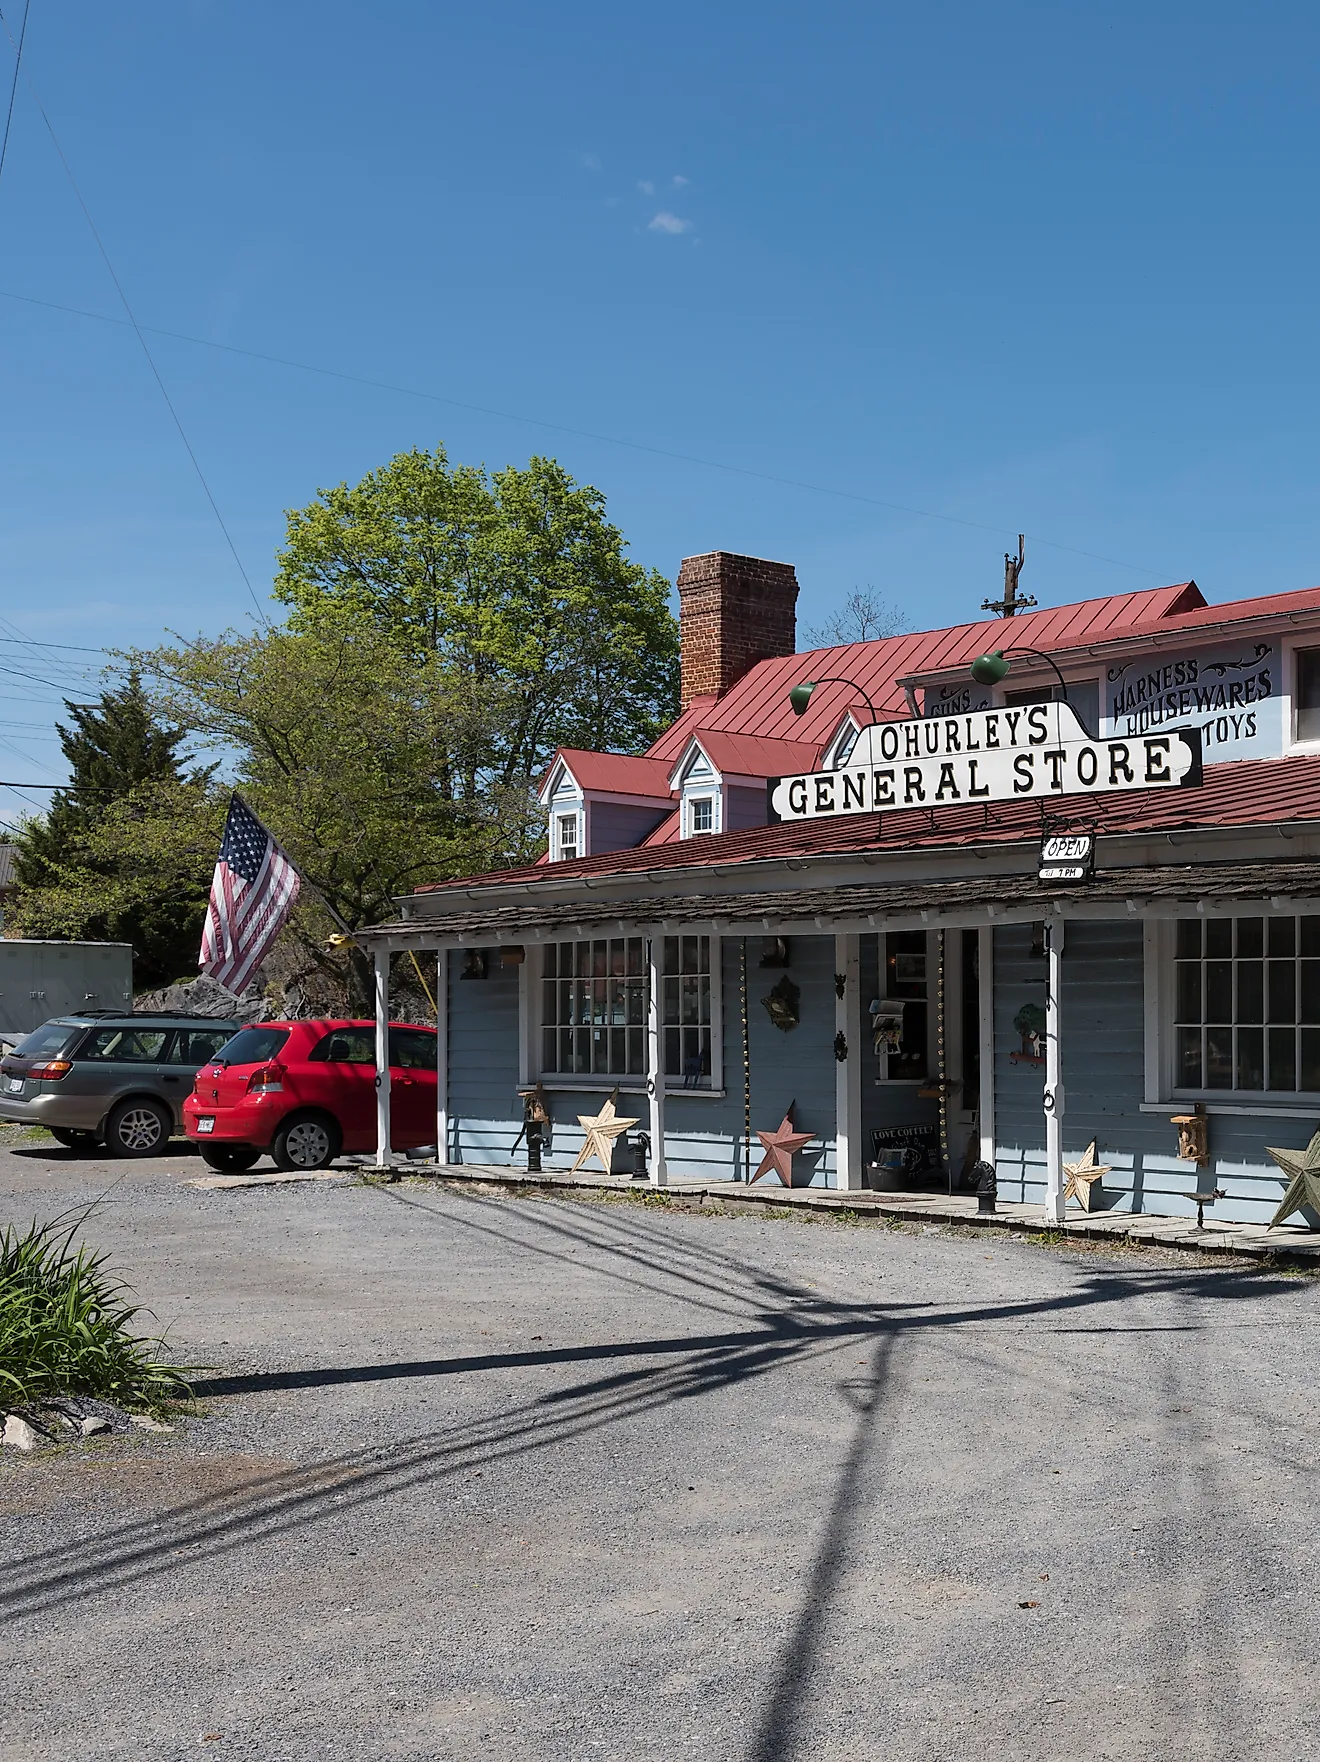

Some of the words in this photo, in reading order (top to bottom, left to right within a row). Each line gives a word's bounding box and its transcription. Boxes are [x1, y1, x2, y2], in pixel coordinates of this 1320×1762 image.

[1113, 659, 1199, 731] HARNESS
[1127, 668, 1272, 736] HOUSEWARES
[880, 704, 1049, 761] O'HURLEY'S
[1202, 711, 1256, 747] TOYS
[788, 759, 990, 815] GENERAL
[1013, 737, 1172, 794] STORE
[1047, 838, 1087, 857] OPEN
[1065, 868, 1077, 876] PM
[873, 1130, 897, 1140] LOVE
